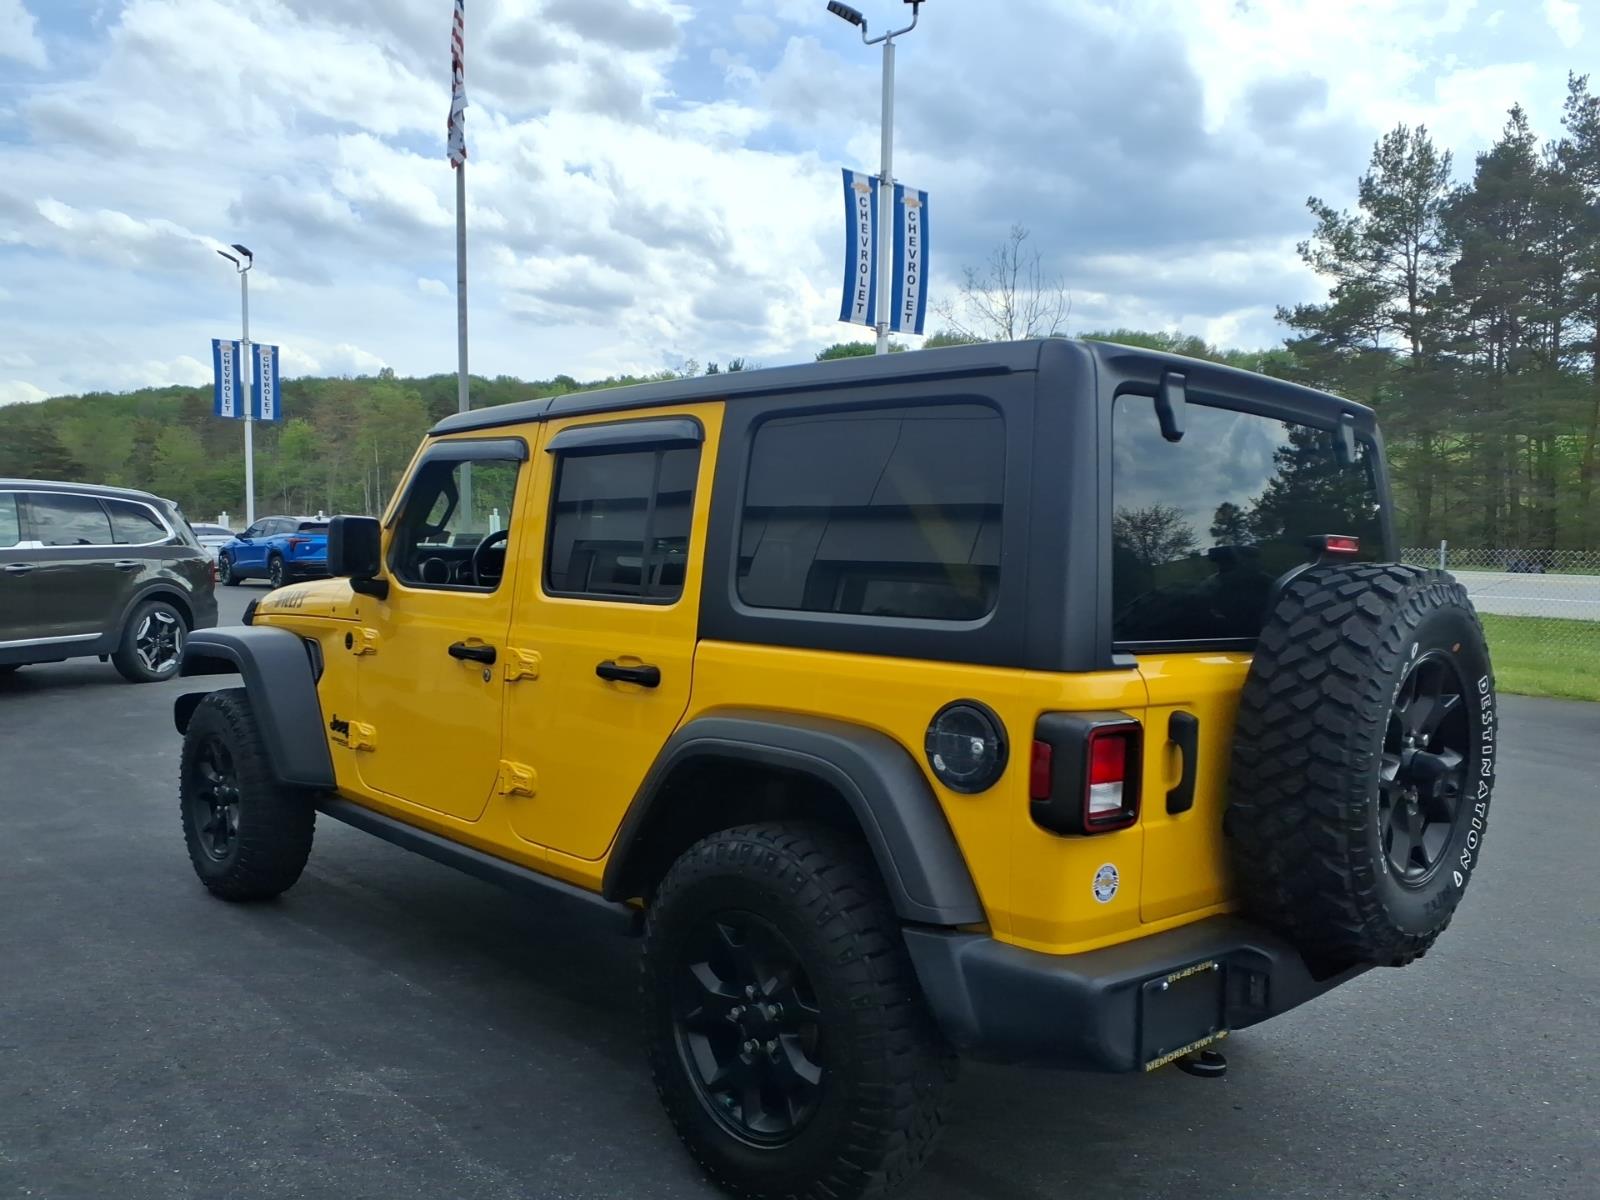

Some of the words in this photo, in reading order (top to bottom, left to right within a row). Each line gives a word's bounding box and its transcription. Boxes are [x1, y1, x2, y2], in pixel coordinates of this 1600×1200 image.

[857, 196, 869, 314] CHEVROLET
[904, 211, 917, 324] CHEVROLET
[223, 352, 232, 411] CHEVROLET
[262, 356, 271, 414] CHEVROLET
[1460, 675, 1493, 871] DESTINATION
[1145, 1043, 1193, 1073] MEMORIAL
[1194, 1035, 1215, 1051] HWY
